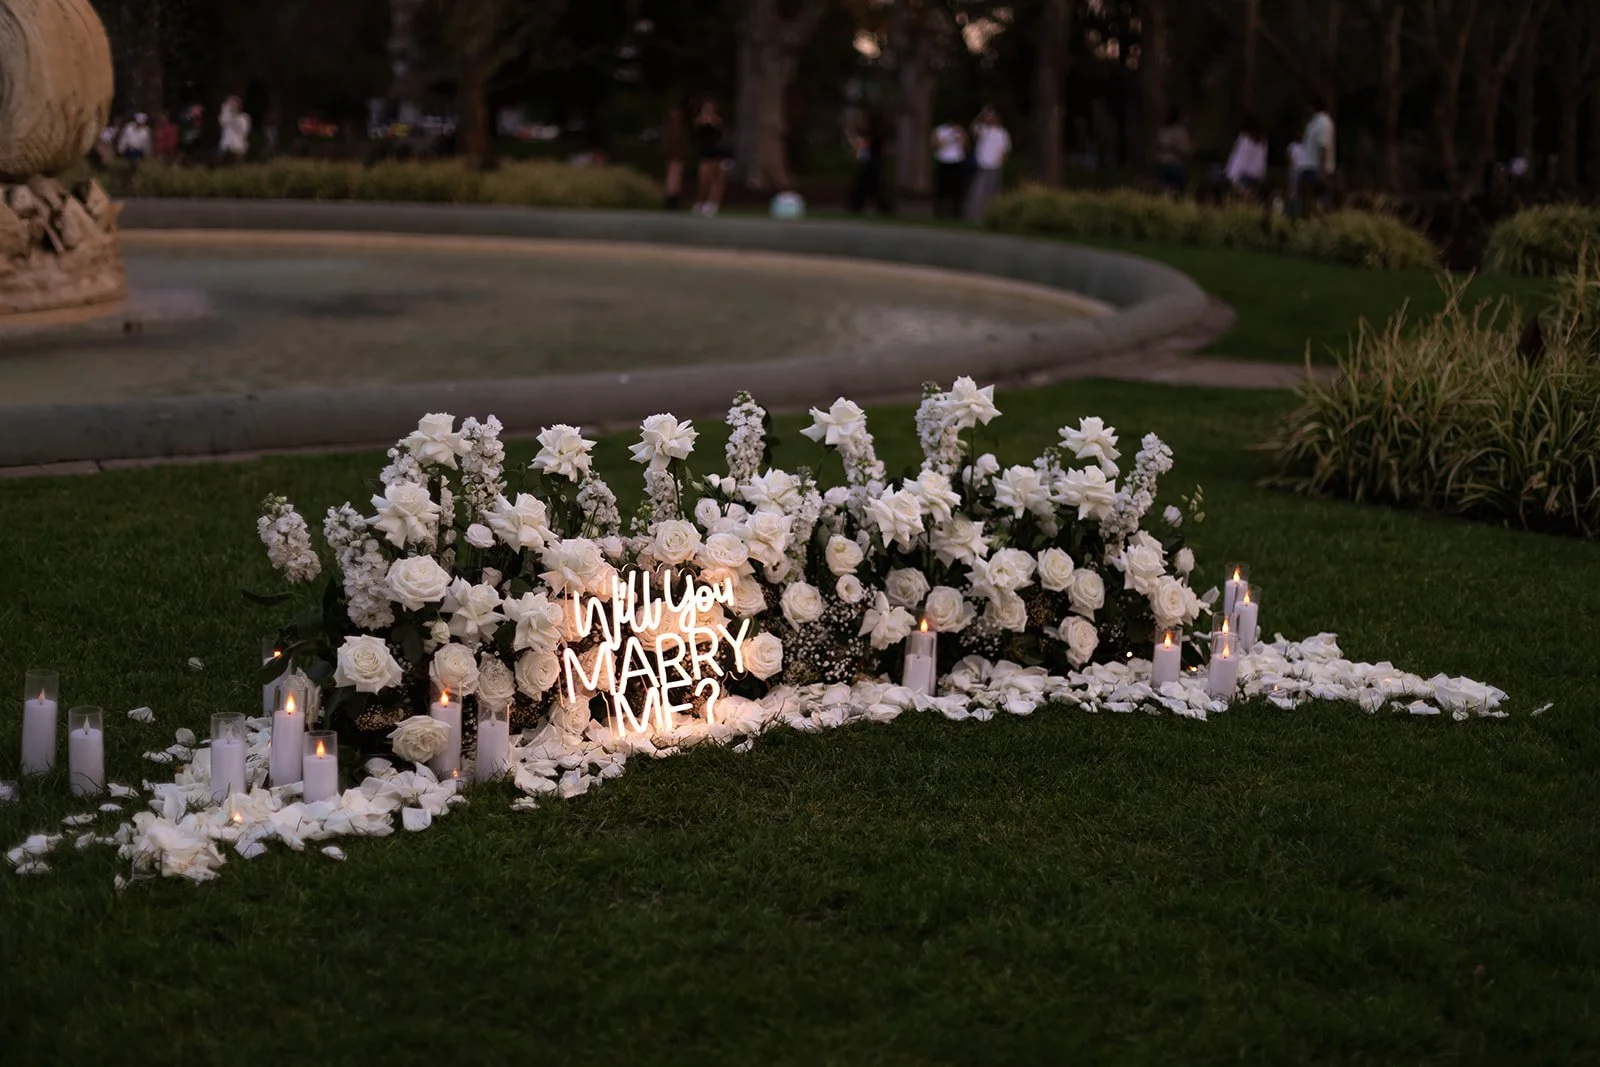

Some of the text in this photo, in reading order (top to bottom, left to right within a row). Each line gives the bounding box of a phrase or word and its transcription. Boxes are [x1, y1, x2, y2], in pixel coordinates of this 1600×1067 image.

[573, 568, 734, 652] Will You
[563, 618, 750, 704] MARRY
[614, 677, 721, 737] ME?
